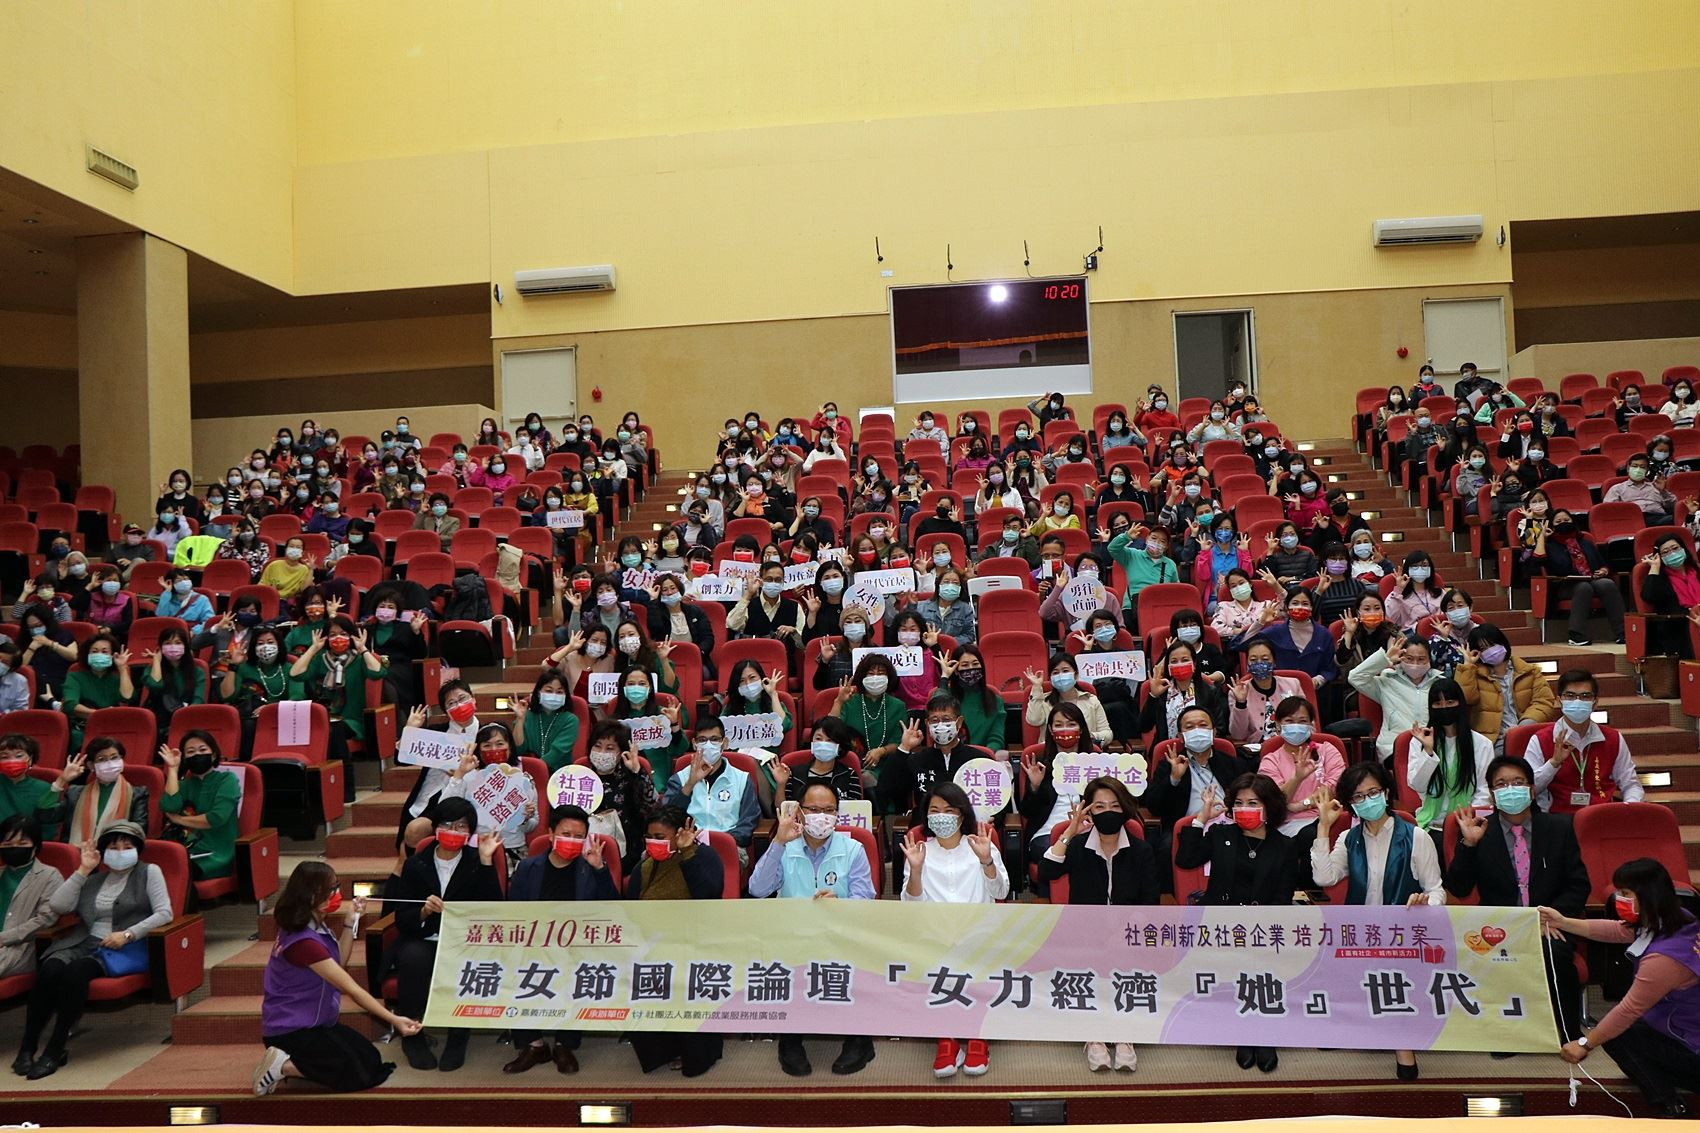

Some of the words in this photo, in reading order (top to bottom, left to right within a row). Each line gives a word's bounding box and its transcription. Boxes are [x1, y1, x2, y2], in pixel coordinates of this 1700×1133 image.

[1082, 659, 1138, 677] 全齡共享
[724, 723, 775, 741] 力在嘉
[558, 773, 596, 792] 社會
[963, 768, 1002, 788] 社會
[1062, 765, 1142, 784] 嘉有社企
[556, 790, 595, 810] 創新
[966, 788, 1002, 807] 企業
[465, 919, 623, 948] 嘉義市110年度
